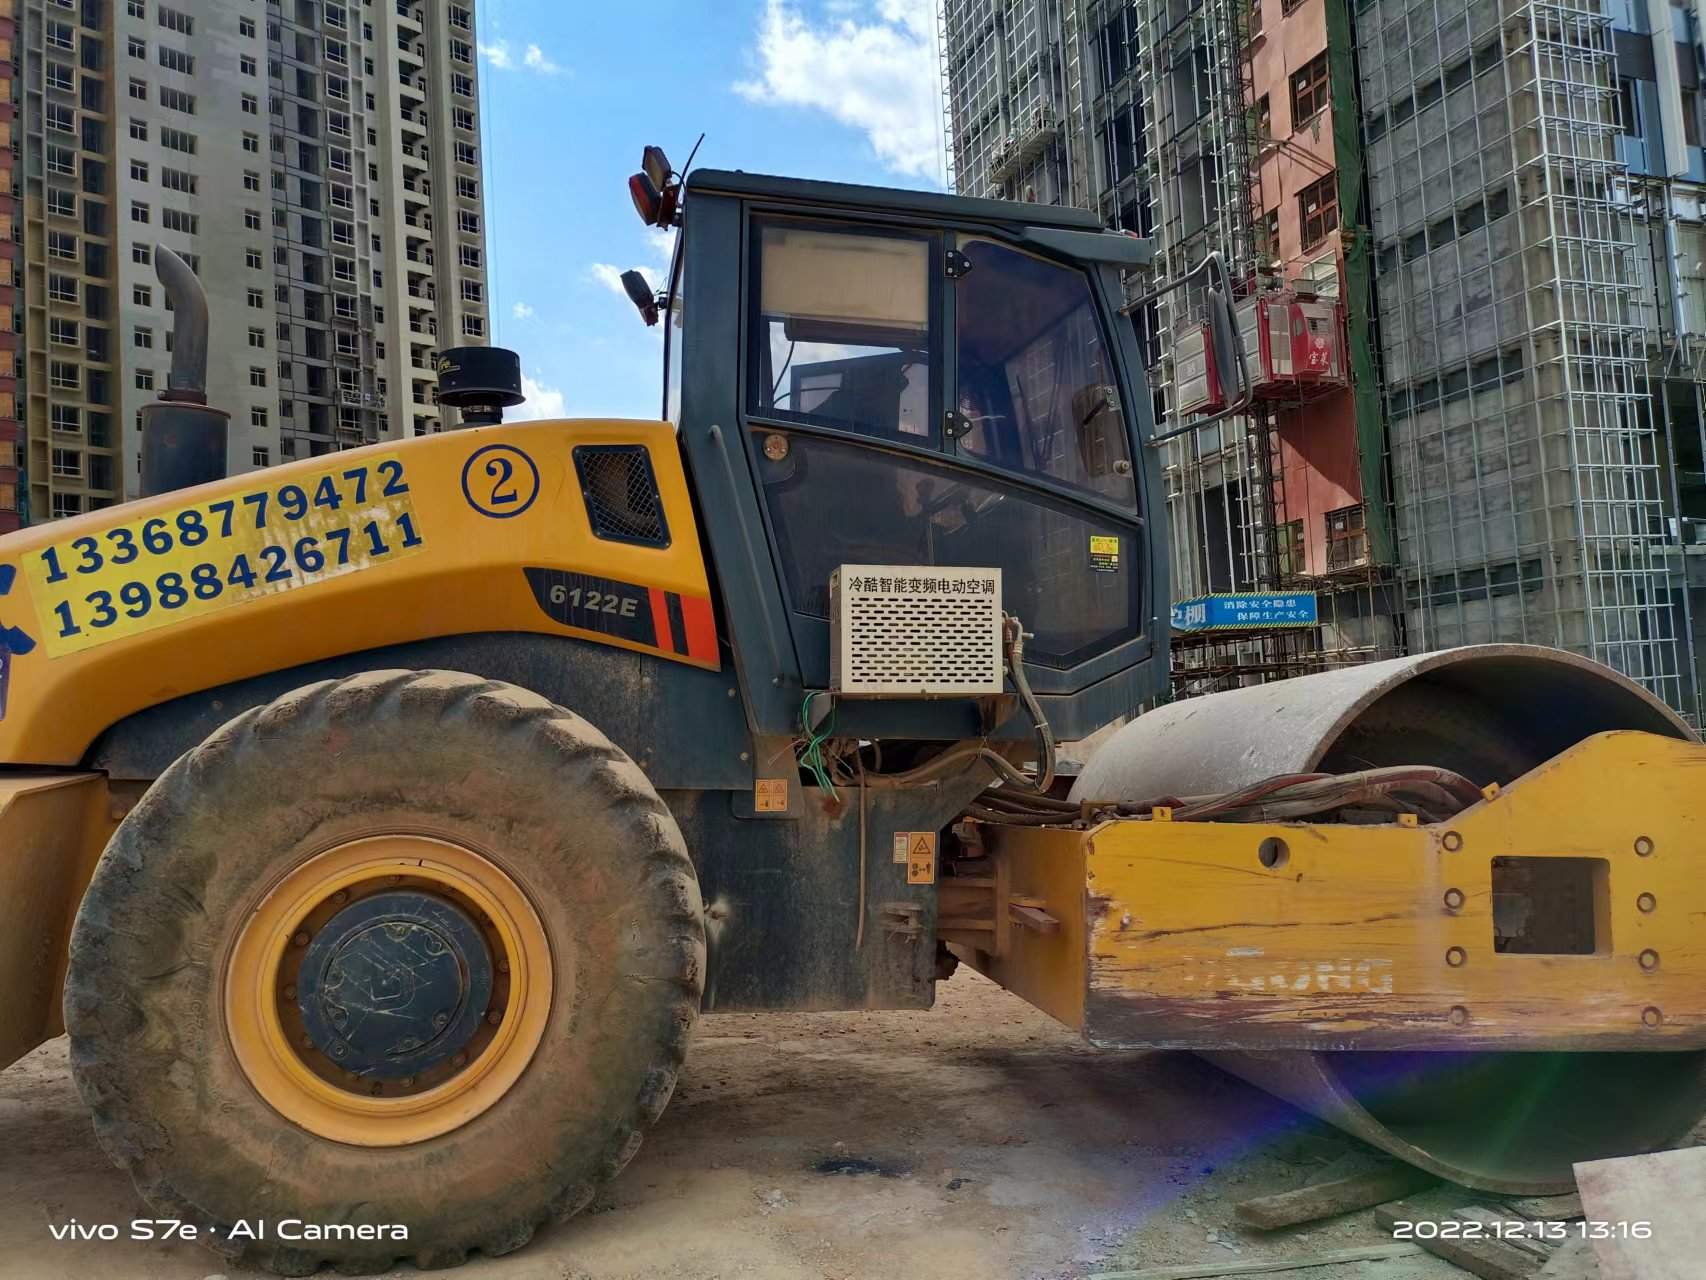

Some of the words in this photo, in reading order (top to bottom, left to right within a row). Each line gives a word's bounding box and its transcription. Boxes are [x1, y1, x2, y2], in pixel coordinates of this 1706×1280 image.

[40, 460, 409, 584] 13368779472
[53, 512, 423, 638] 13988426711
[849, 576, 995, 595] 冷酷智能变频电动空调
[550, 585, 638, 617] 6122E
[1224, 599, 1296, 609] 消除安全隐患
[1237, 610, 1309, 621] 保障生产安全
